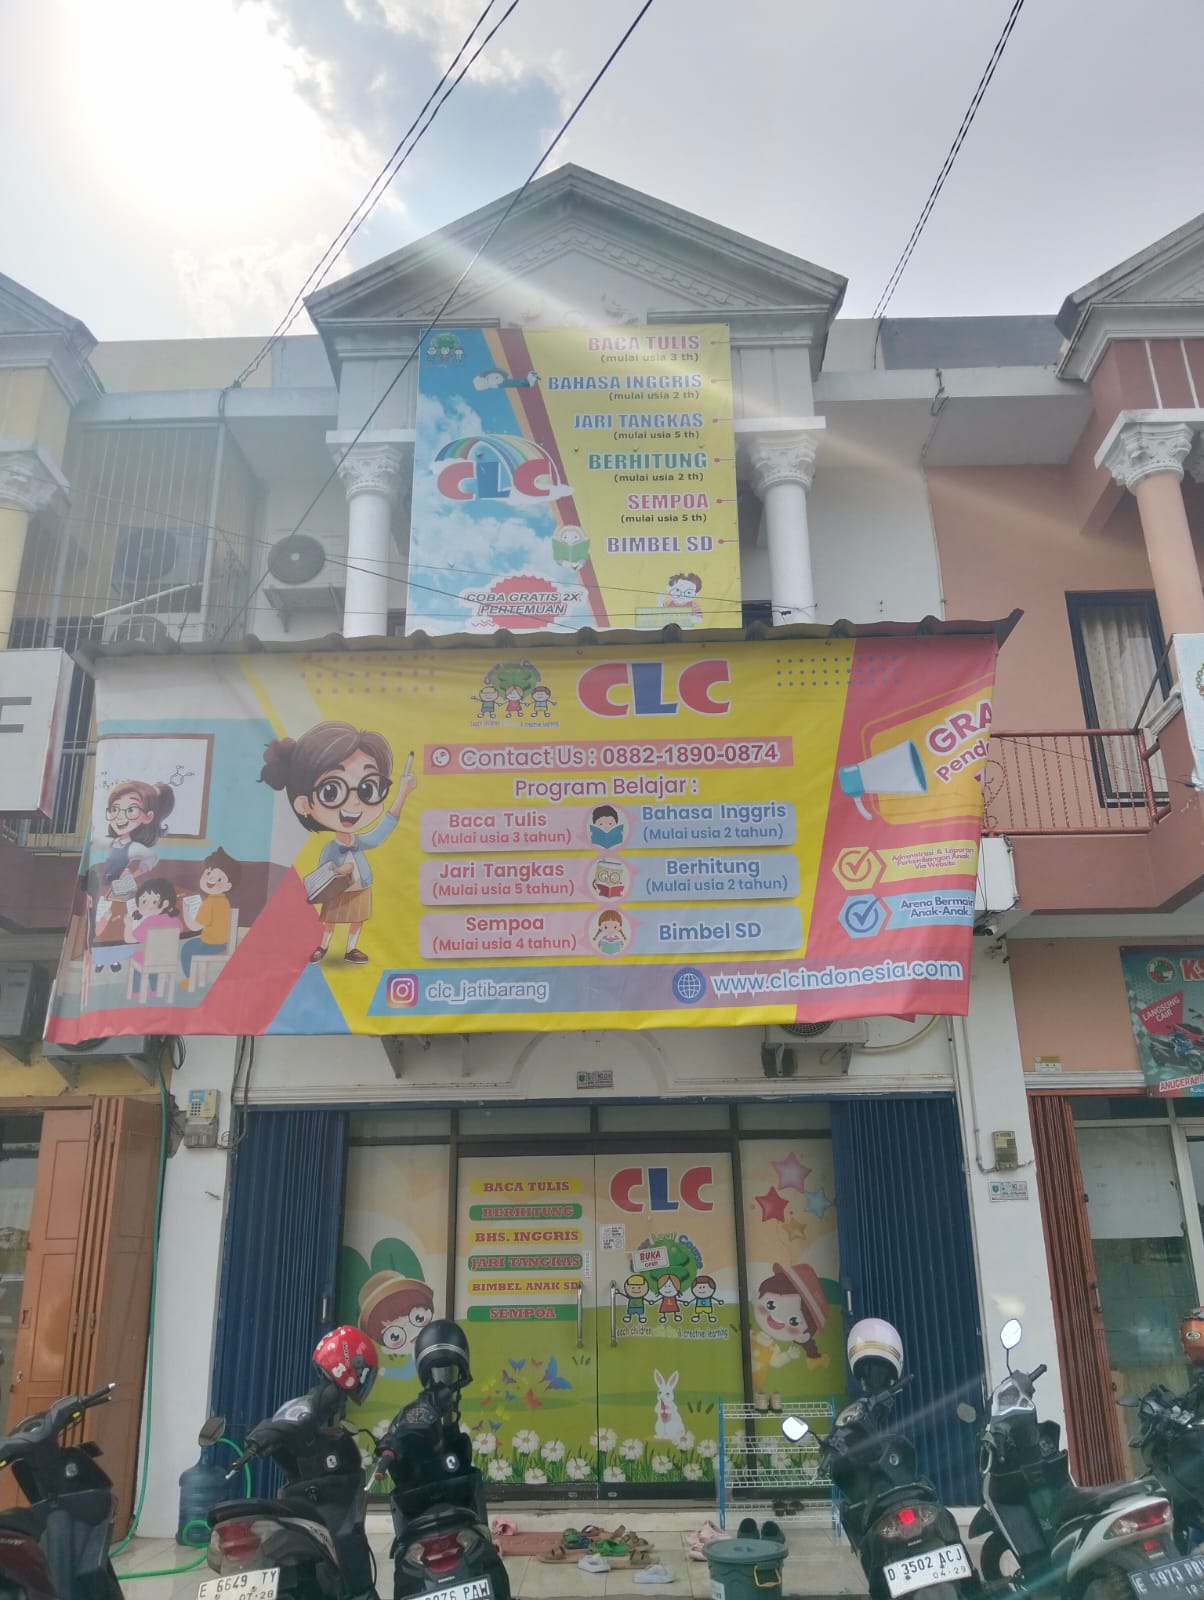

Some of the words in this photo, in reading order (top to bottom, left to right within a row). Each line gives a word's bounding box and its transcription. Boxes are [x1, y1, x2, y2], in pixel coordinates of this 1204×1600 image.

[588, 336, 640, 352] BACA
[646, 335, 700, 350] TULIS
[600, 353, 638, 364] (mulai
[643, 353, 667, 362] usia
[670, 353, 678, 362] 3
[681, 352, 699, 363] th)
[549, 376, 621, 390] BAHASA
[626, 374, 703, 389] INGGRIS
[609, 391, 644, 401] (mulai
[647, 391, 670, 400] usia
[673, 391, 680, 399] 2
[683, 390, 700, 400] th)
[574, 414, 612, 429] JARI
[618, 413, 704, 428] TANGKAS
[613, 431, 647, 441] (mulai
[650, 431, 671, 440] usia
[675, 431, 682, 439] 5
[683, 430, 700, 440] th)
[588, 452, 707, 470] BERHITUNG
[437, 459, 553, 500] CLC
[614, 473, 649, 483] (mulai
[652, 473, 674, 482] usia
[678, 473, 685, 481] 2
[687, 472, 704, 482] th)
[628, 493, 709, 510] SEMPOA
[620, 514, 654, 524] (mulai
[657, 514, 679, 523] usia
[681, 514, 688, 522] 5
[691, 513, 707, 523] th)
[607, 537, 681, 552] BIMBEL
[687, 536, 713, 551] SD
[466, 593, 505, 602] COBA
[509, 592, 559, 602] GRATIS
[480, 604, 565, 615] PERTEMUAN
[577, 659, 731, 717] CLC
[460, 750, 552, 768] Contact
[557, 748, 583, 766] Us
[602, 744, 779, 766] 0882-1890-0874
[936, 739, 989, 781] Pend
[514, 778, 607, 800] Program
[613, 776, 687, 799] Belajar
[449, 813, 495, 828] Baca
[504, 811, 547, 827] Tulis
[642, 805, 713, 821] Bahasa
[720, 802, 787, 823] Inggris
[432, 829, 477, 846] (Mulai
[479, 830, 510, 843] usia
[512, 831, 521, 842] 3
[523, 829, 571, 846] tahun)
[643, 826, 688, 843] (Mulai
[691, 826, 721, 839] usia
[724, 826, 732, 838] 2
[735, 823, 784, 840] tahun)
[440, 862, 475, 878] Jari
[483, 862, 565, 882] Tangkas
[667, 858, 760, 877] Berhitung
[433, 881, 478, 899] (Mulai
[481, 882, 511, 895] usia
[515, 883, 523, 894] 5
[527, 880, 575, 897] tahun)
[646, 878, 691, 895] (Mulai
[694, 879, 724, 891] usia
[727, 879, 735, 890] 2
[738, 875, 788, 892] tahun)
[901, 899, 933, 909] Arena
[934, 896, 975, 907] Bermain
[466, 916, 544, 936] Sempoa
[659, 922, 731, 941] Bimbel
[735, 922, 762, 939] SD
[433, 936, 478, 954] (Mulai
[482, 937, 511, 950] usia
[515, 938, 524, 949] 4
[528, 934, 577, 951] tahun)
[714, 961, 962, 992] www.clcindonesia.com
[427, 981, 548, 1004] clc_jatibarang
[1142, 996, 1180, 1020] LANGSUNG
[1156, 1008, 1173, 1022] CAIR
[483, 1182, 524, 1192] BACA
[528, 1181, 569, 1192] TULIS
[610, 1167, 714, 1213] CLC
[482, 1206, 574, 1217] BERHITUNG
[475, 1231, 511, 1242] BHS.
[514, 1231, 578, 1242] INGGRIS
[471, 1256, 505, 1271] JARI
[510, 1256, 580, 1267] TANGKAS
[640, 1250, 661, 1261] BUKA
[472, 1282, 523, 1292] BIMBEL
[526, 1281, 560, 1291] ANAK
[563, 1281, 578, 1291] SD
[490, 1308, 556, 1319] SEMPOA
[887, 1568, 896, 1581] D
[901, 1556, 933, 1575] 3502
[938, 1548, 962, 1568] ACJ
[200, 1583, 208, 1598] E
[216, 1574, 248, 1593] 6649
[261, 1569, 277, 1585] TY
[463, 1581, 488, 1600] PAW
[1136, 1577, 1147, 1592] E
